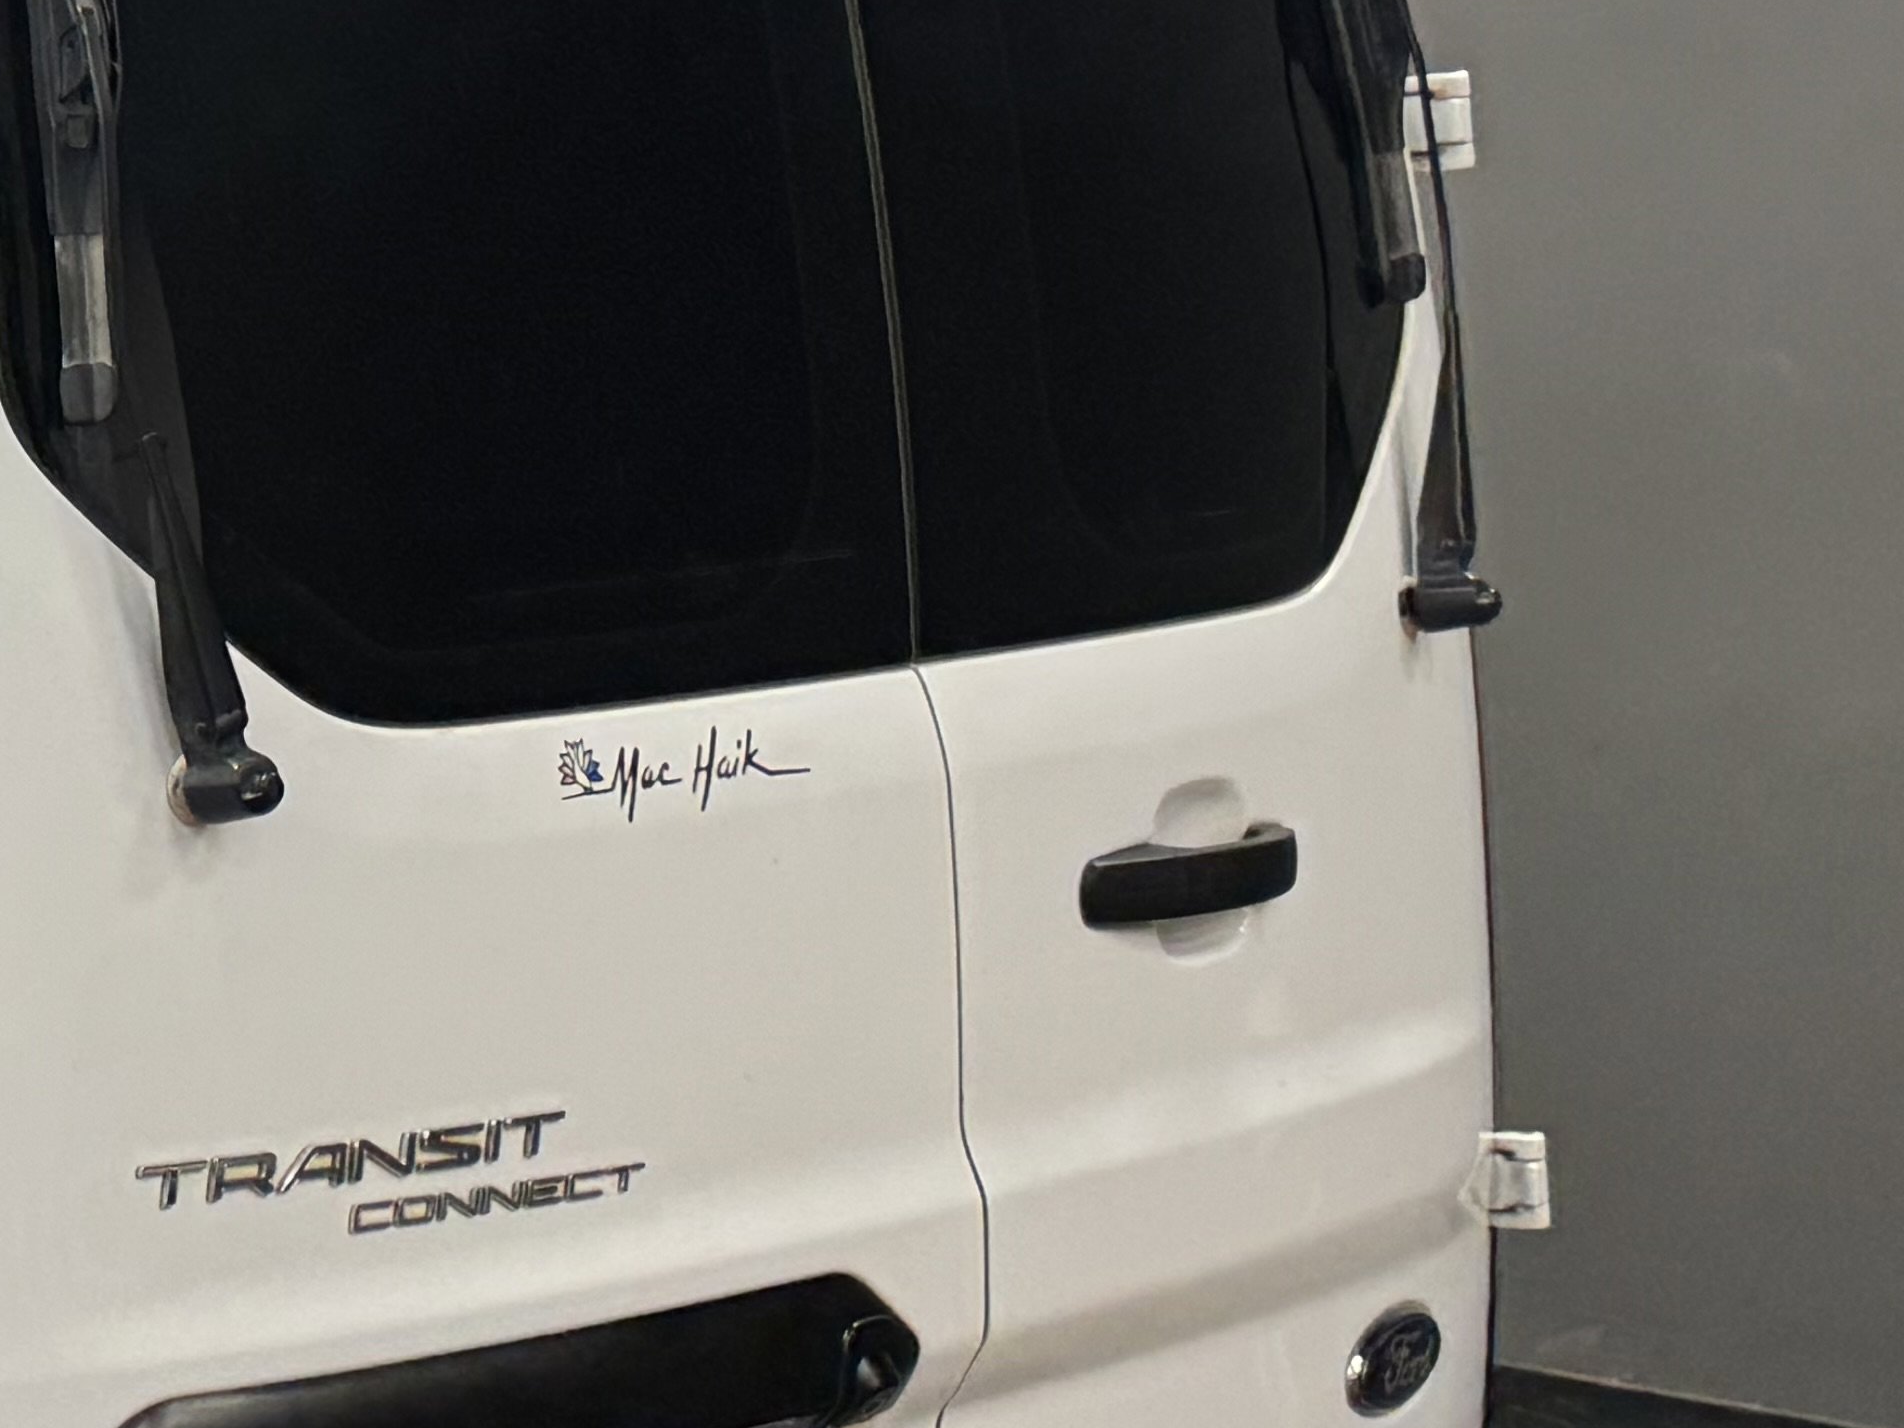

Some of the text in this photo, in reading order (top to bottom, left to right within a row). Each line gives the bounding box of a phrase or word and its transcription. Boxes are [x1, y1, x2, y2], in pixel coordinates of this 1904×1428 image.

[611, 725, 811, 823] Mac Haik
[135, 1110, 566, 1211] TRANSIT
[348, 1163, 646, 1235] CONNECT
